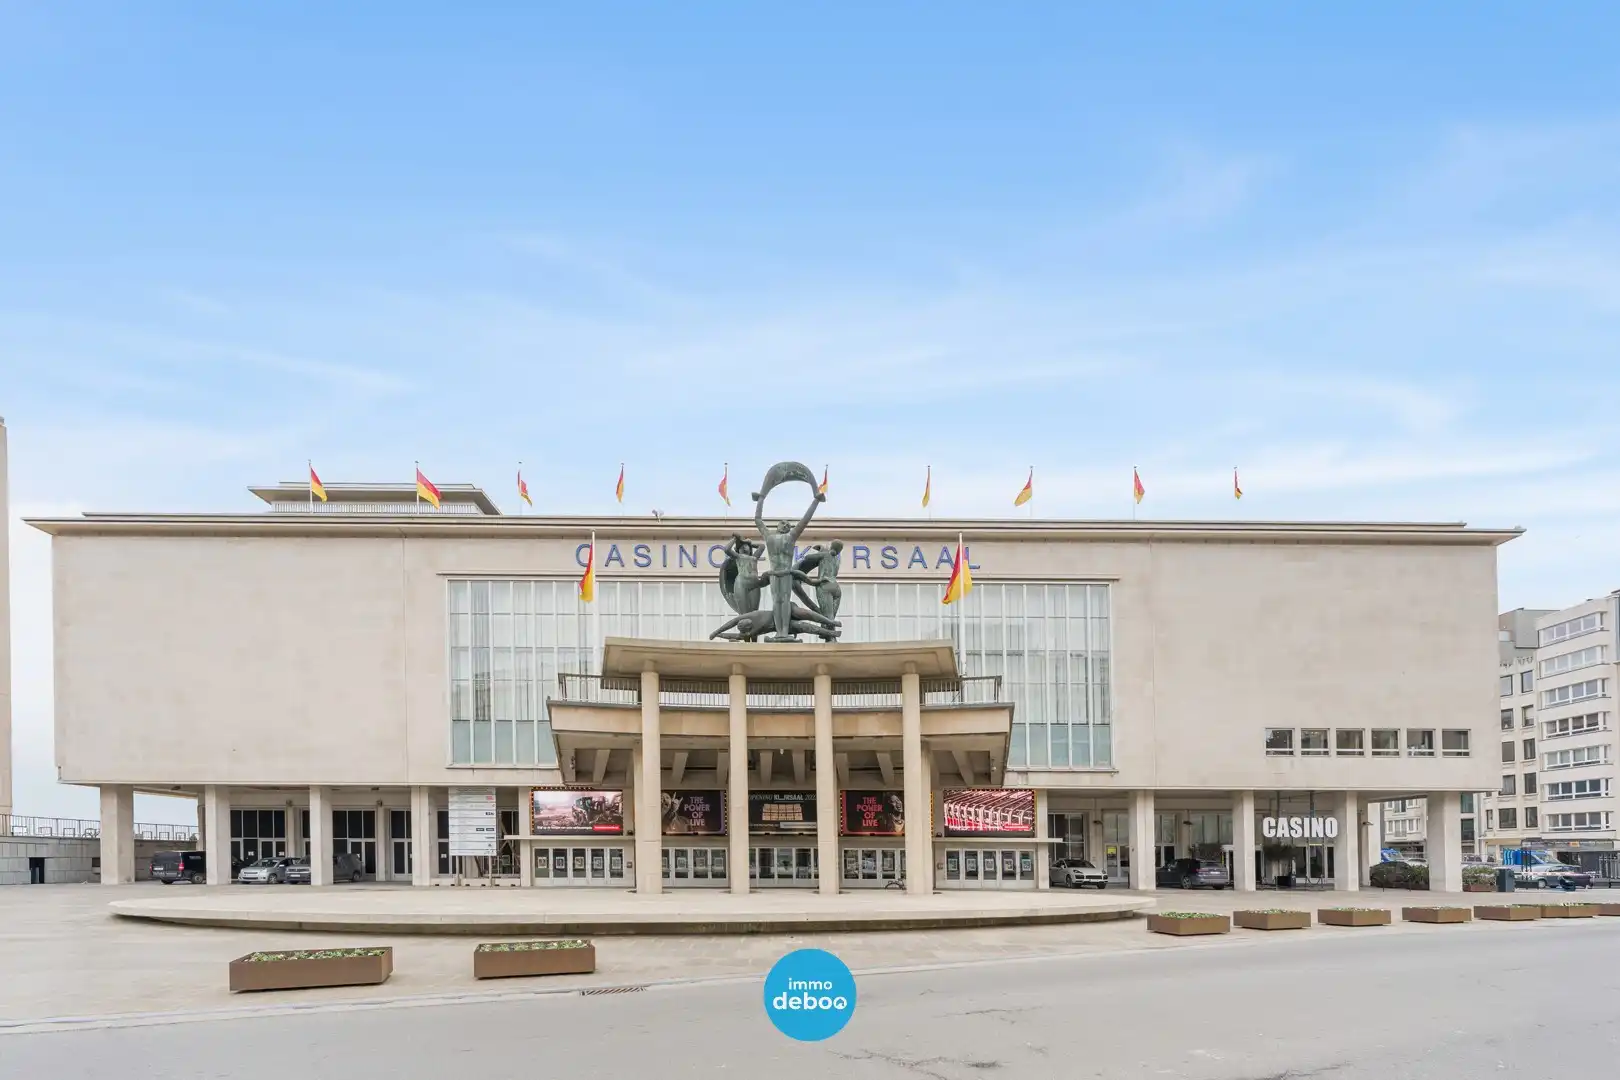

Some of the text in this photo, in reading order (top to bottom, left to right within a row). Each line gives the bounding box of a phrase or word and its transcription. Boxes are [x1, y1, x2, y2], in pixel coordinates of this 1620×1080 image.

[575, 543, 727, 568] CASINO
[794, 545, 980, 570] KRSAAL
[690, 796, 704, 804] THE
[862, 796, 877, 804] THE
[684, 804, 710, 812] POWER
[856, 804, 883, 812] POWER
[691, 811, 704, 819] OF
[864, 811, 876, 819] OF
[862, 819, 878, 827] LIVE
[1262, 816, 1338, 838] CASINO
